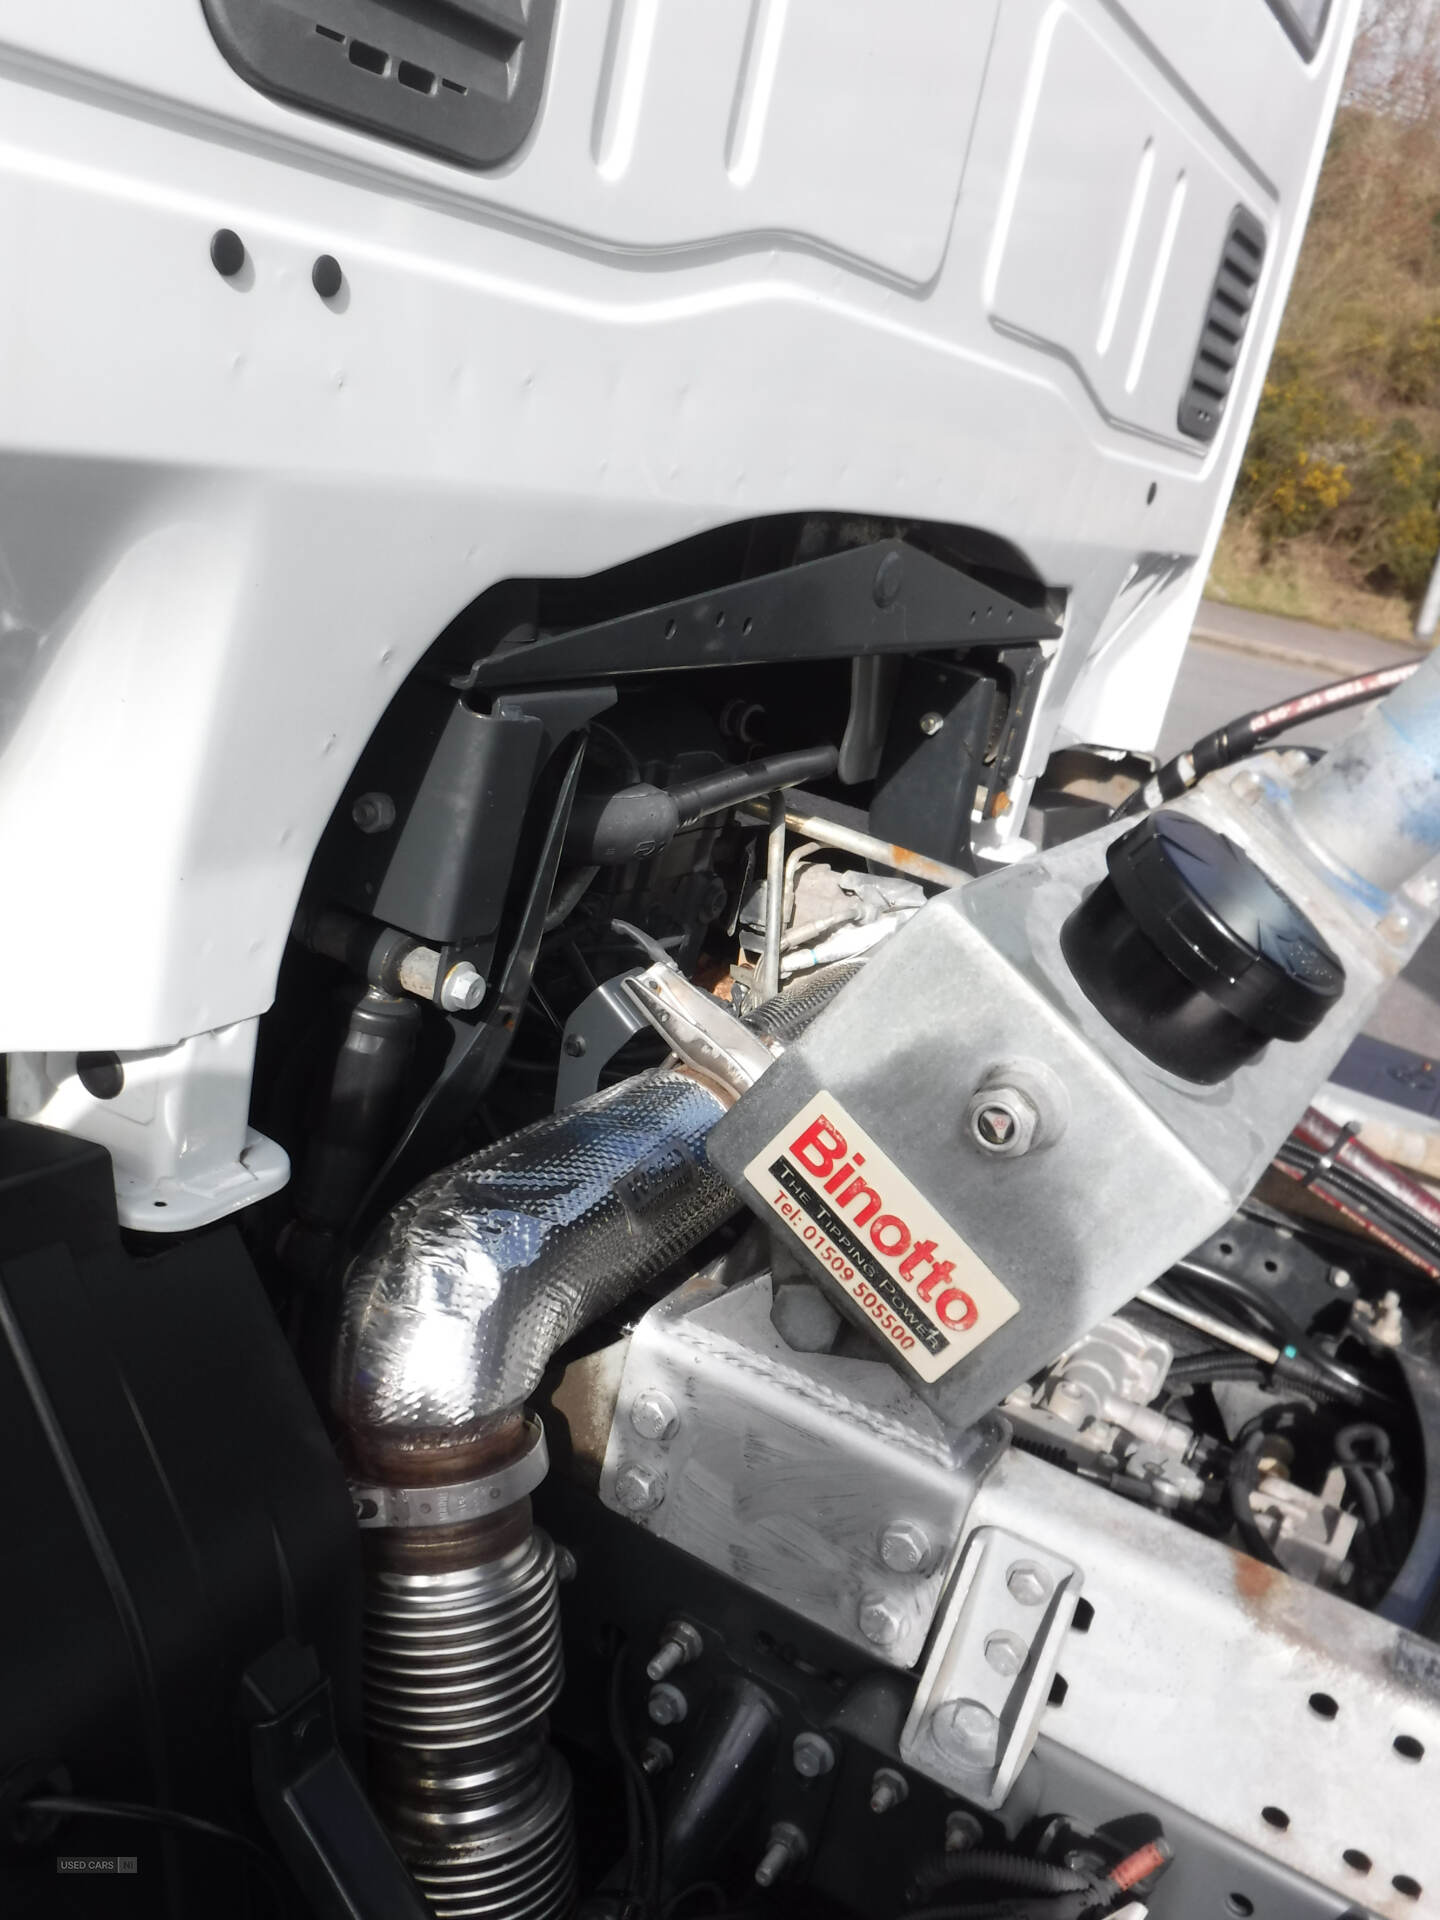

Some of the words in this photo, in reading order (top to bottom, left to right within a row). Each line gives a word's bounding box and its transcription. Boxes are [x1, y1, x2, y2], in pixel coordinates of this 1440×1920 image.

[772, 1190, 804, 1227] Tel:
[803, 1225, 856, 1282] 01509
[853, 1281, 915, 1350] 505500
[780, 1163, 812, 1206] THE
[816, 1207, 879, 1280] TIPPING
[878, 1278, 942, 1351] POWER
[788, 1114, 979, 1332] Binotto
